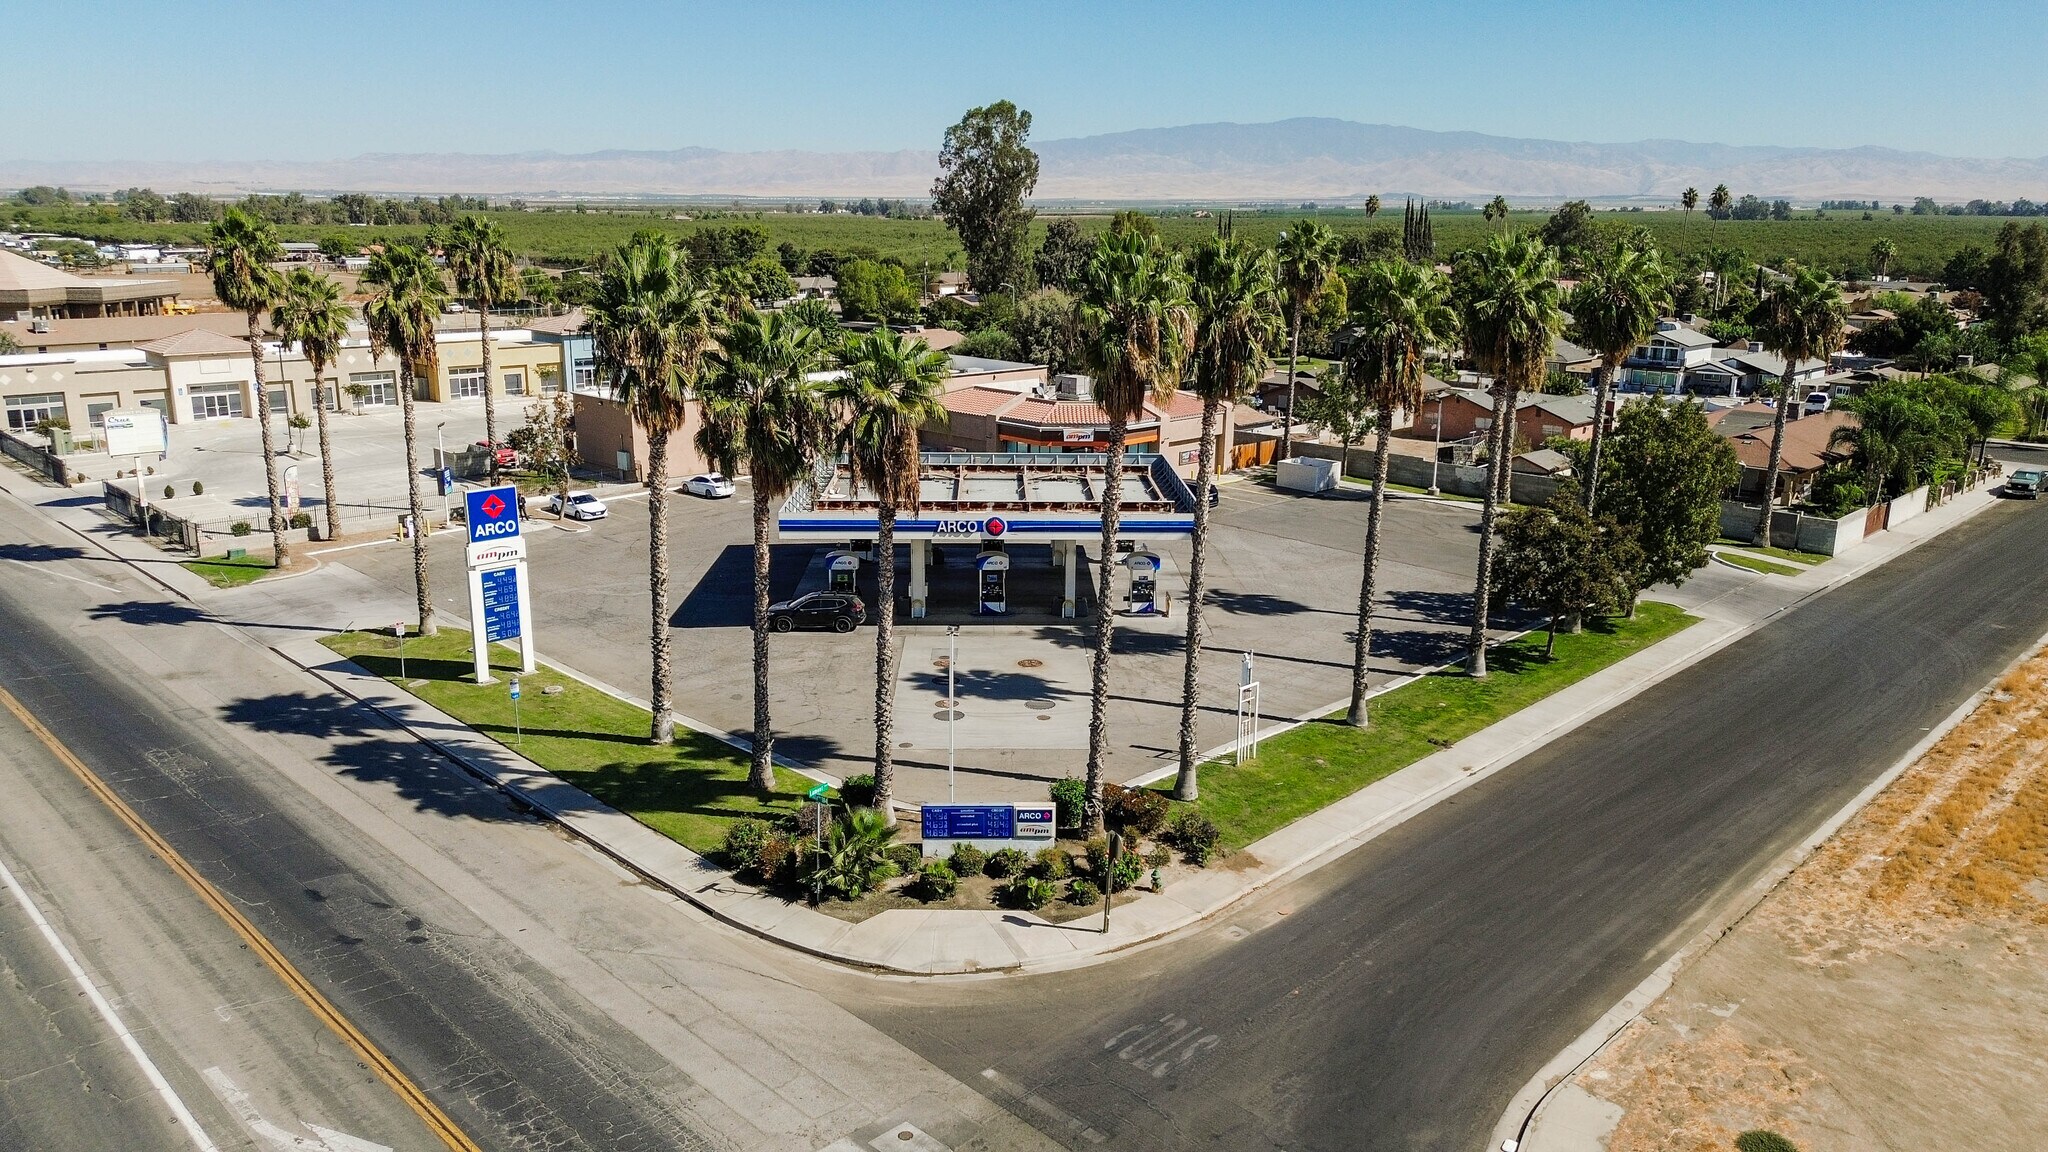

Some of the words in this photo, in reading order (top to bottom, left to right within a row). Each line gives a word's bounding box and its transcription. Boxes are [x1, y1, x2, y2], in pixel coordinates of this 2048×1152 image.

[475, 519, 516, 537] ARCO
[937, 520, 978, 533] ARCO
[477, 550, 518, 560] ampm
[1018, 812, 1042, 820] ARCO
